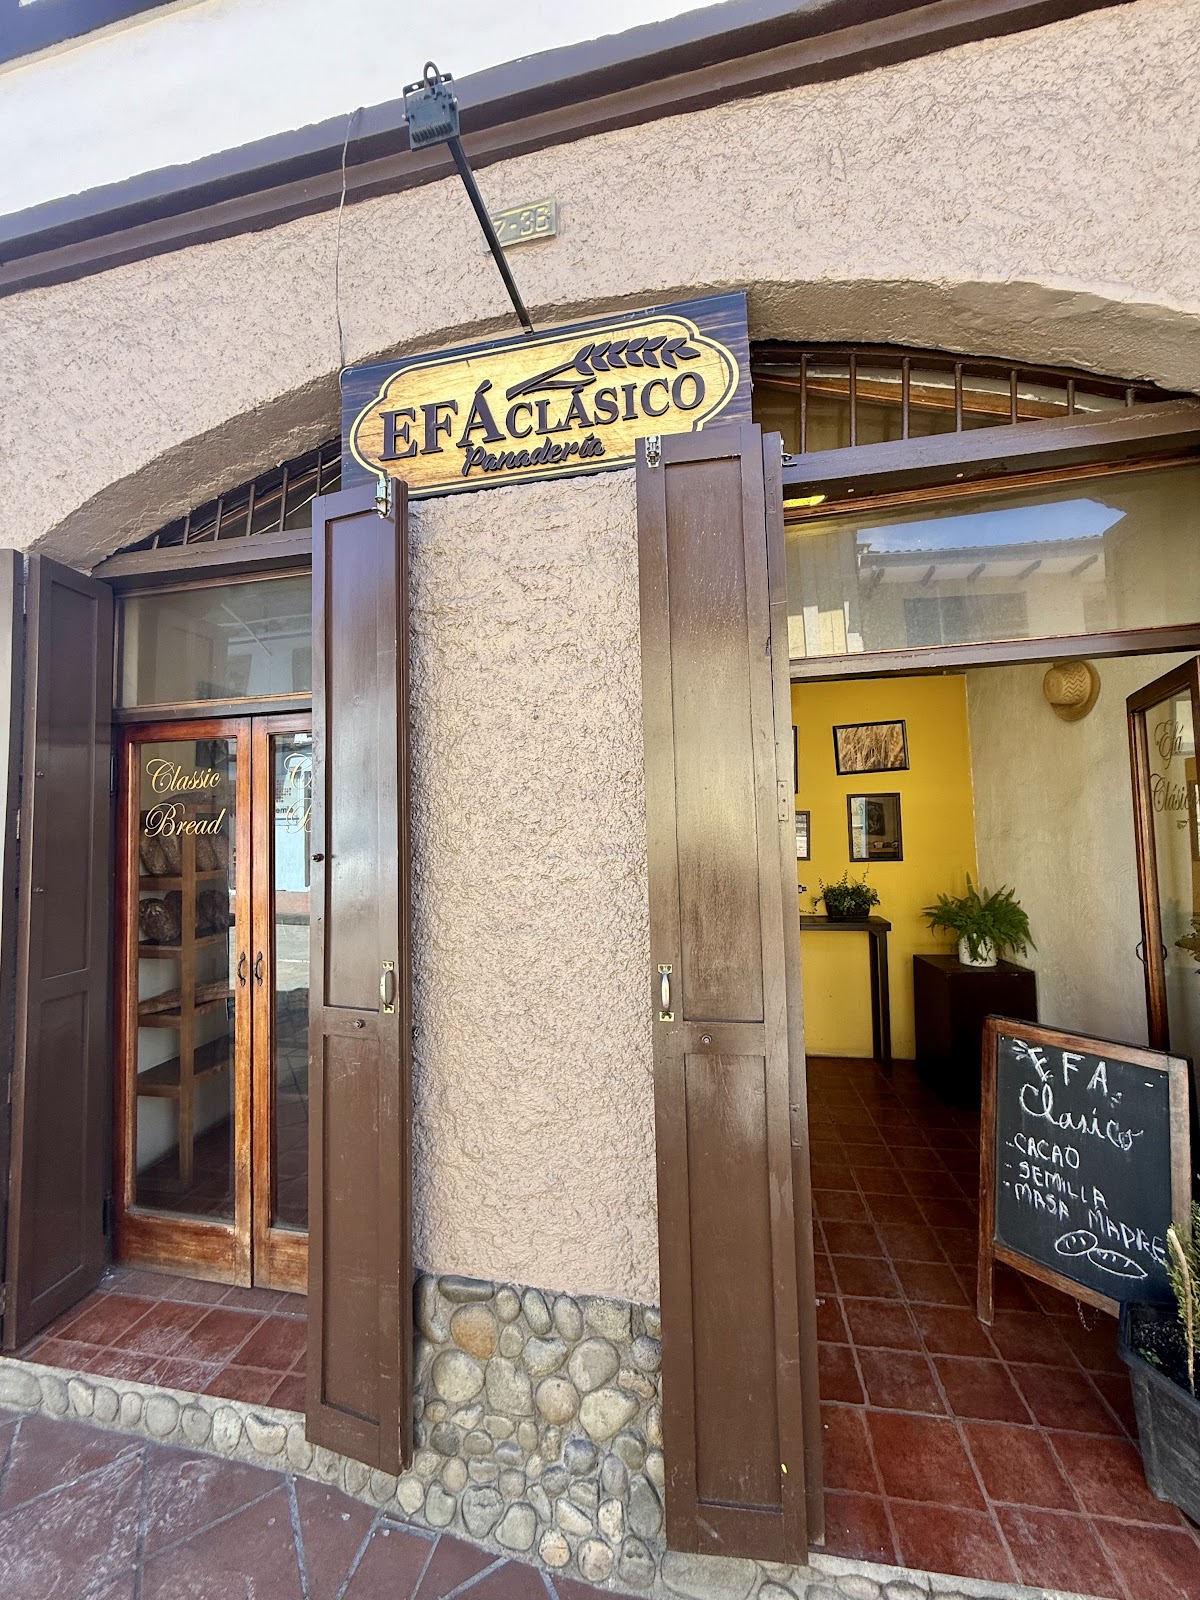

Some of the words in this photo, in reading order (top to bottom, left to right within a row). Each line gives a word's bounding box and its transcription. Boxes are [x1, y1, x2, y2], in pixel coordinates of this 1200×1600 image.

[378, 379, 504, 462] EFÁ
[505, 371, 706, 439] CLÁSICO
[461, 437, 606, 477] Panadería
[146, 758, 221, 794] Classic
[144, 802, 227, 838] Bread
[1014, 1132, 1080, 1169] CACAO
[1019, 1161, 1108, 1210] SEMILLA
[1014, 1182, 1071, 1222] MASA
[1088, 1205, 1169, 1268] MADRE
